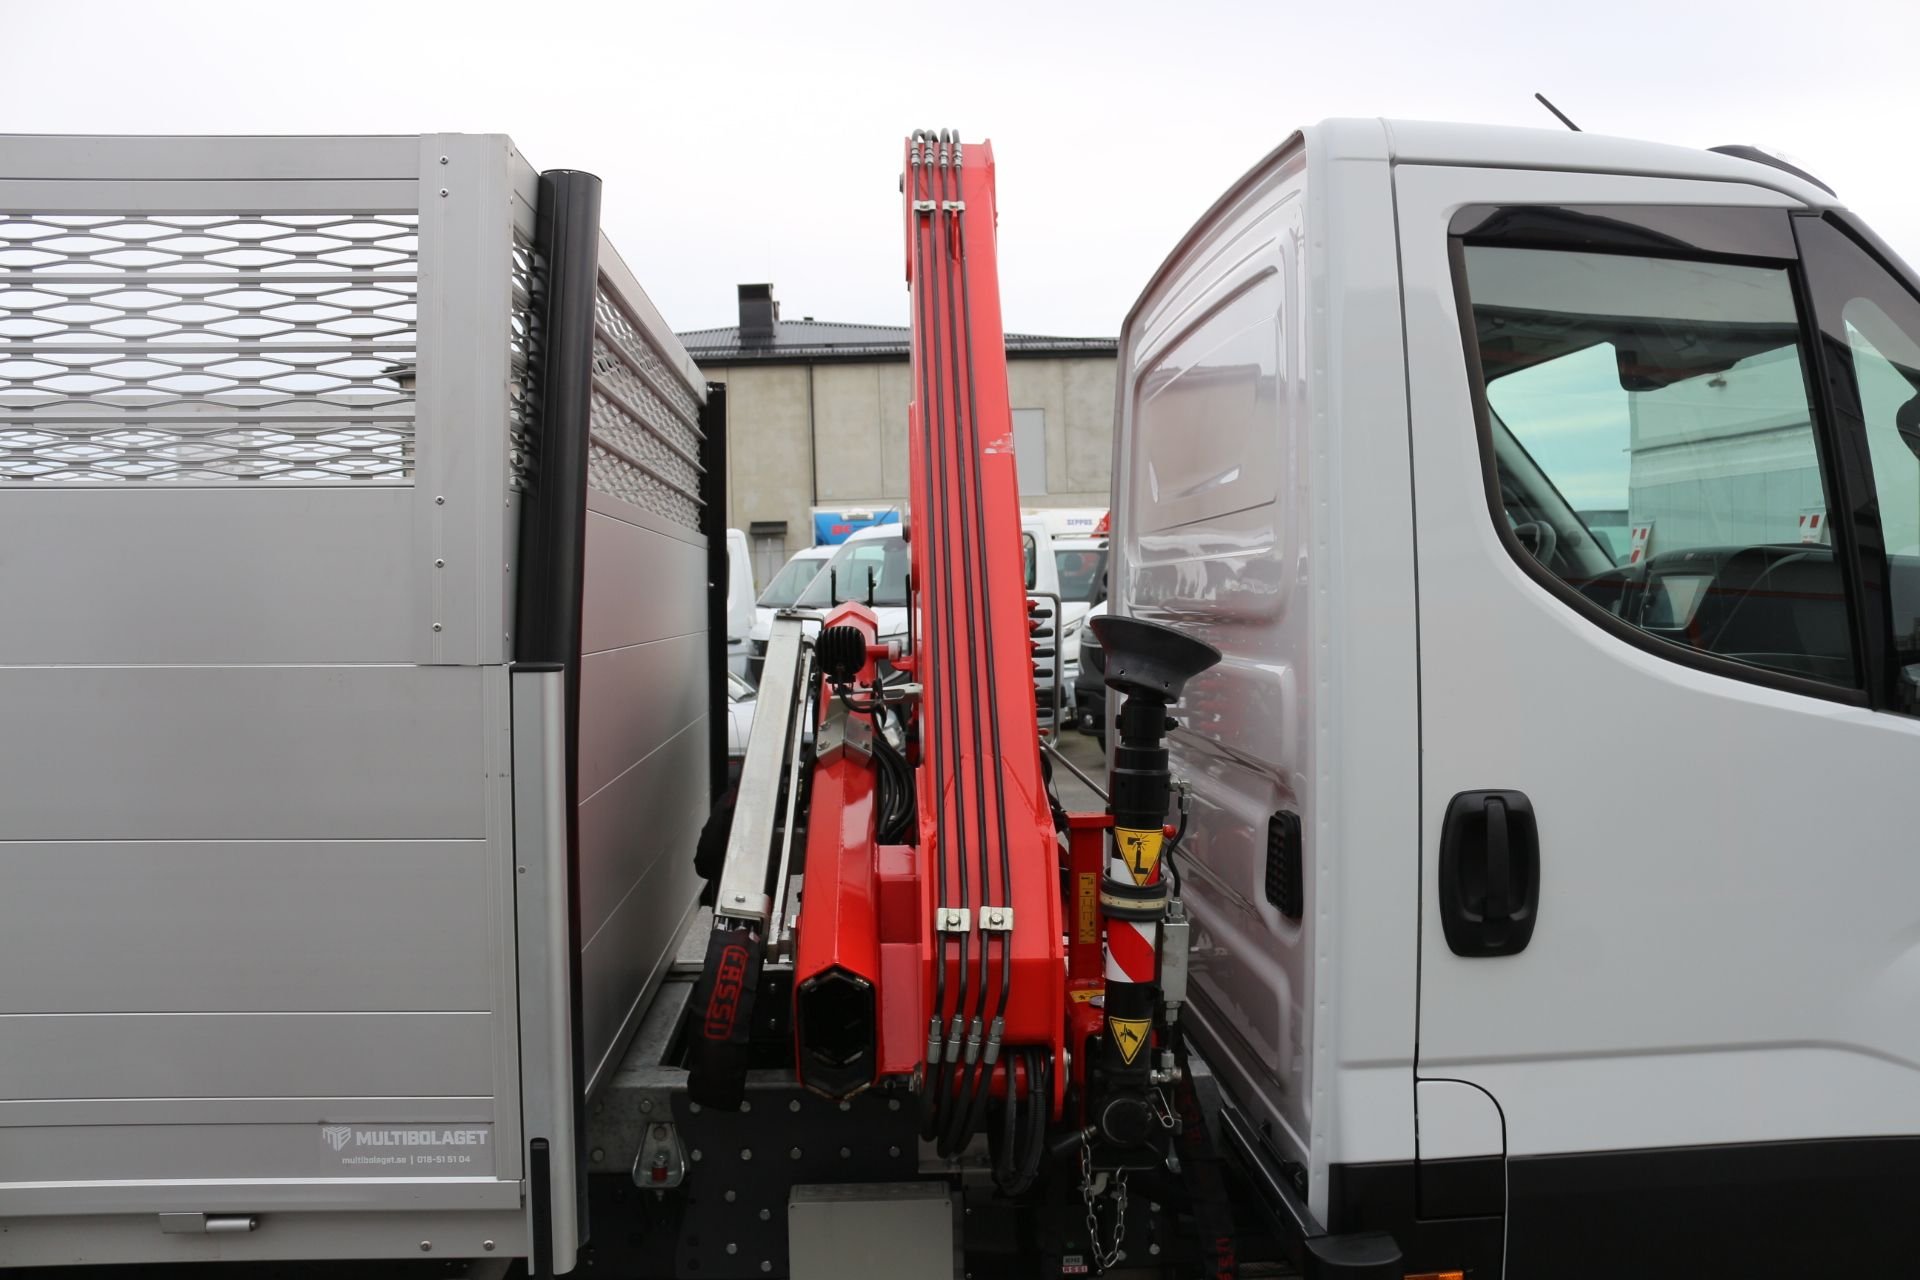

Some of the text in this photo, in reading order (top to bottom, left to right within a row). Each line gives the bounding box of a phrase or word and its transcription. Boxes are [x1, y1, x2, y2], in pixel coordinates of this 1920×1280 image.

[707, 949, 746, 1032] FASSI
[356, 1130, 488, 1146] MULTIBOLAGET
[342, 1155, 407, 1165] multibolaget.se
